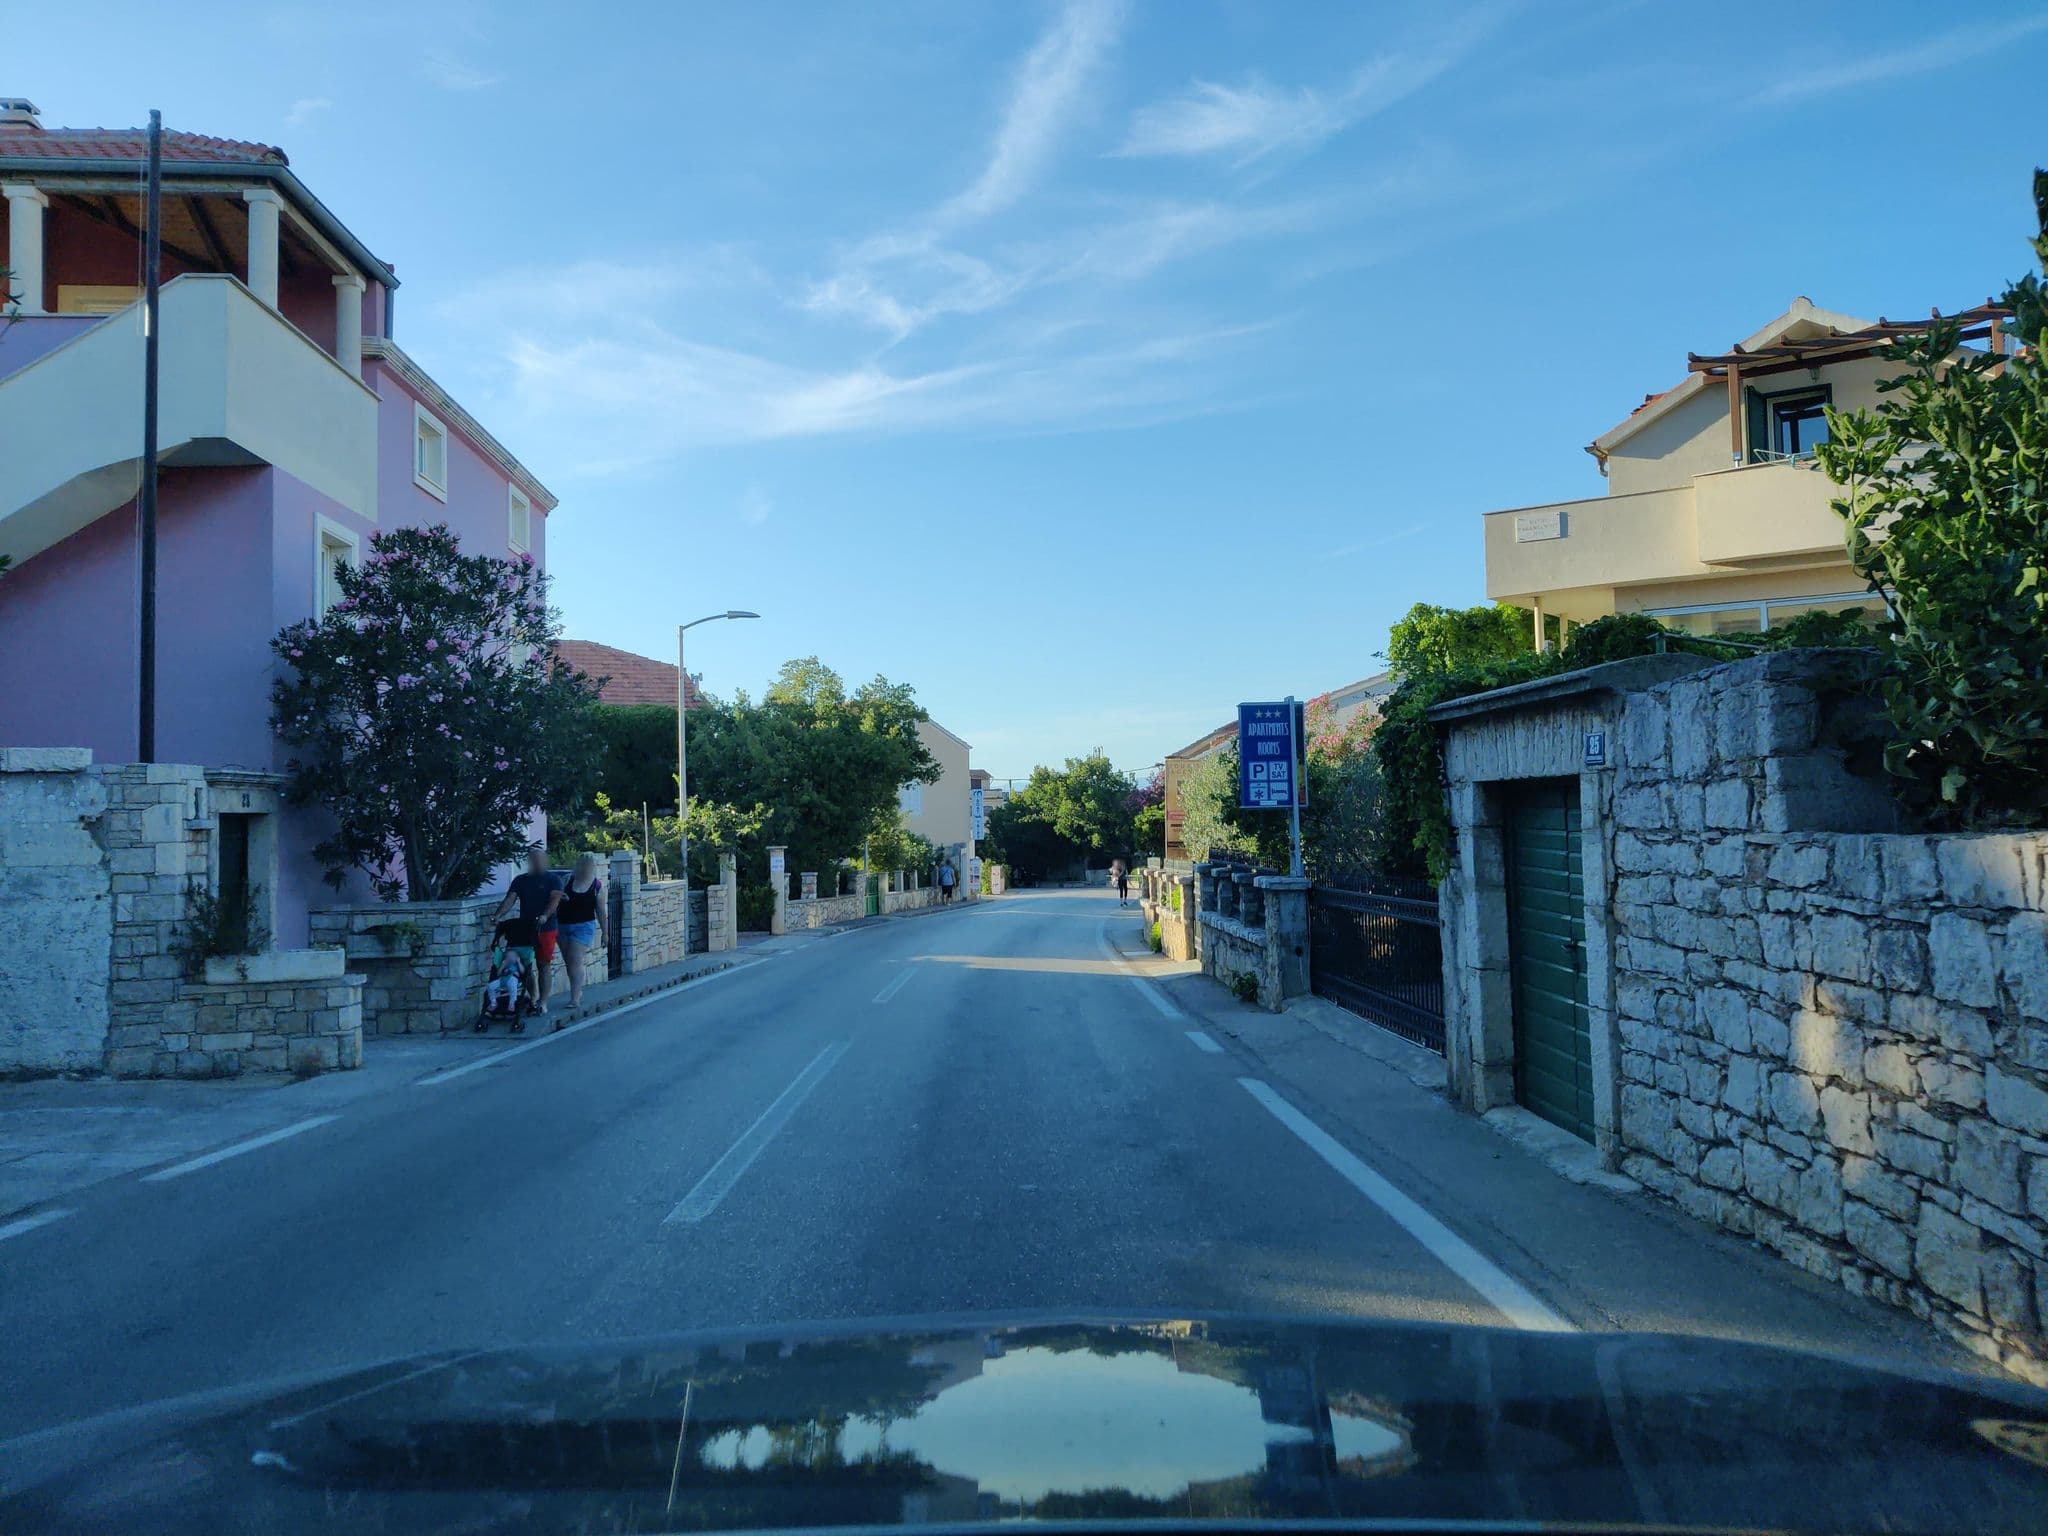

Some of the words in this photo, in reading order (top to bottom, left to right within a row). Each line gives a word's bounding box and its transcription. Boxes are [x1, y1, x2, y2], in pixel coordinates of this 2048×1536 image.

[1248, 722, 1289, 736] APARTMENTS
[1258, 741, 1280, 755] ROOMS
[1590, 735, 1600, 754] 25
[1253, 764, 1264, 778] P
